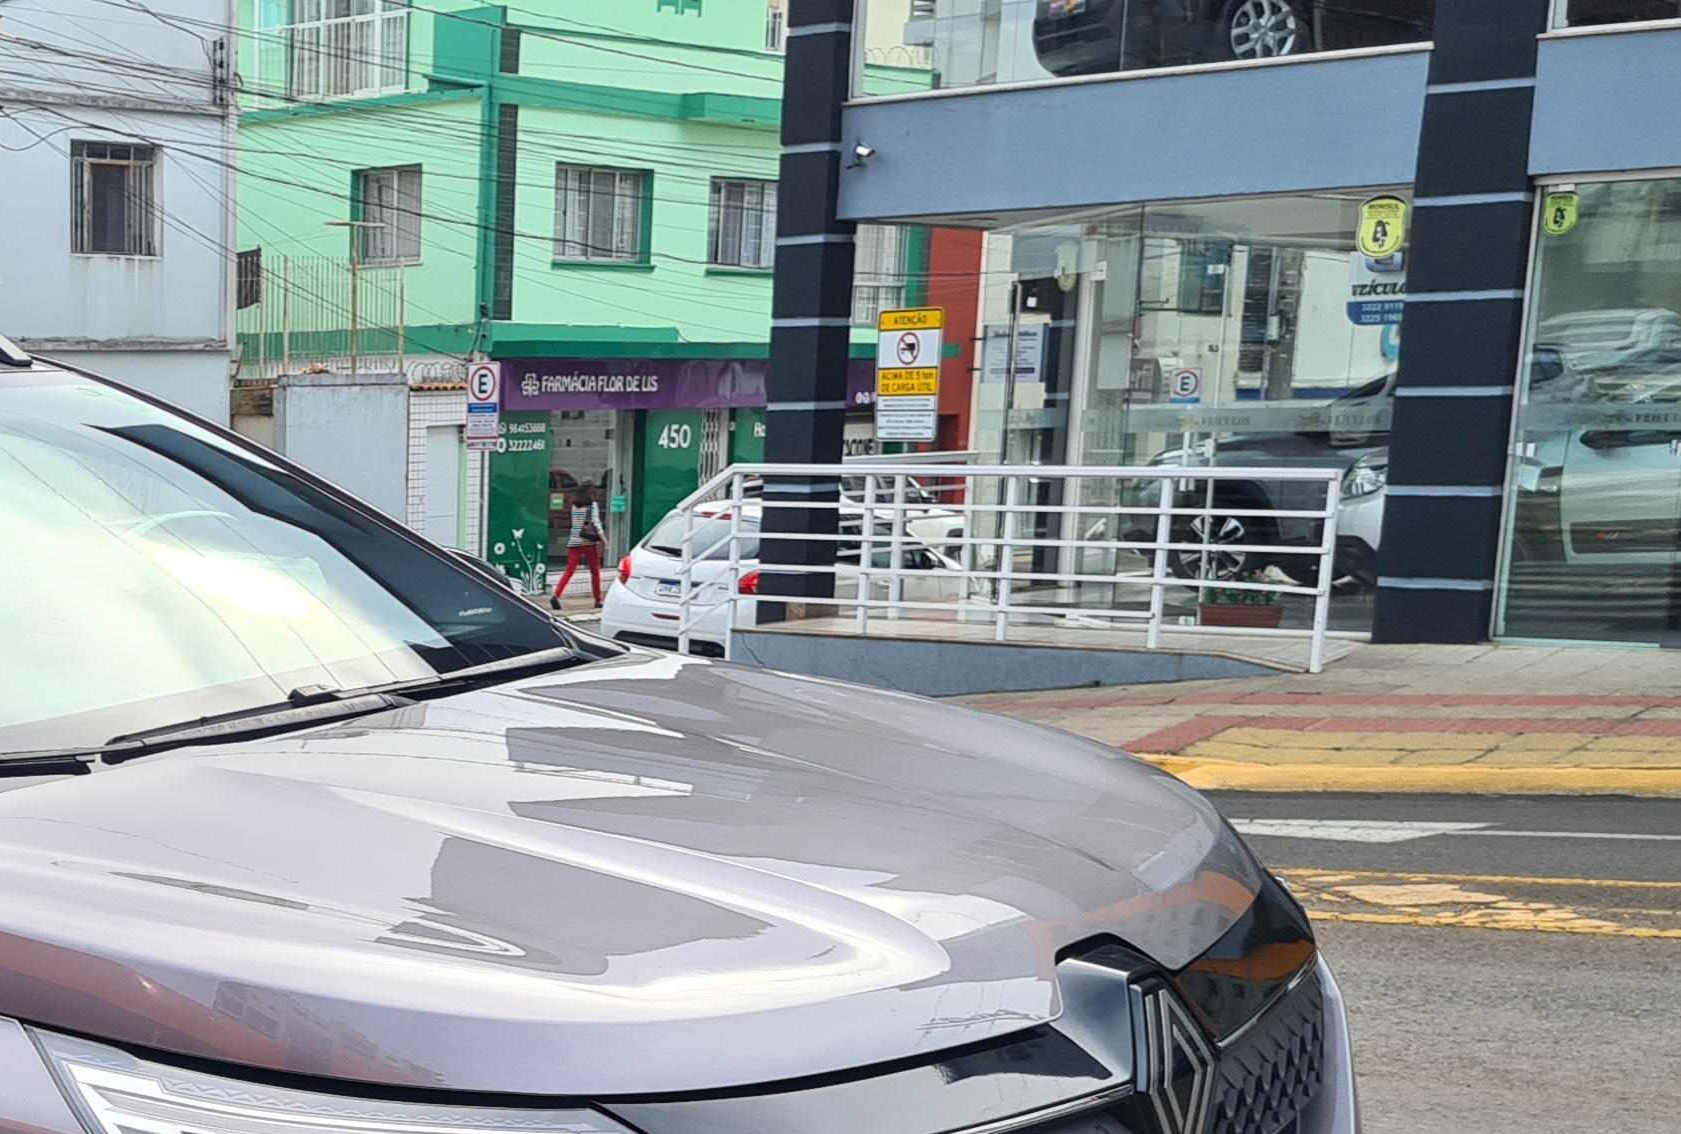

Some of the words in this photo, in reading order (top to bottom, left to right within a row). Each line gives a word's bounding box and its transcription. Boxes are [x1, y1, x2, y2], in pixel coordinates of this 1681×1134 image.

[1351, 279, 1406, 297] VEÍCULO
[893, 312, 928, 326] ATENÇÃO
[478, 374, 488, 394] E
[541, 371, 596, 392] FARMÁCIA
[598, 375, 624, 392] FLOR
[626, 375, 640, 392] DE
[641, 375, 658, 392] LIS
[881, 371, 903, 381] ACIMA
[904, 371, 914, 380] DE
[1180, 376, 1191, 391] E
[881, 383, 890, 392] DE
[891, 382, 915, 392] CARGA
[658, 424, 691, 449] 450
